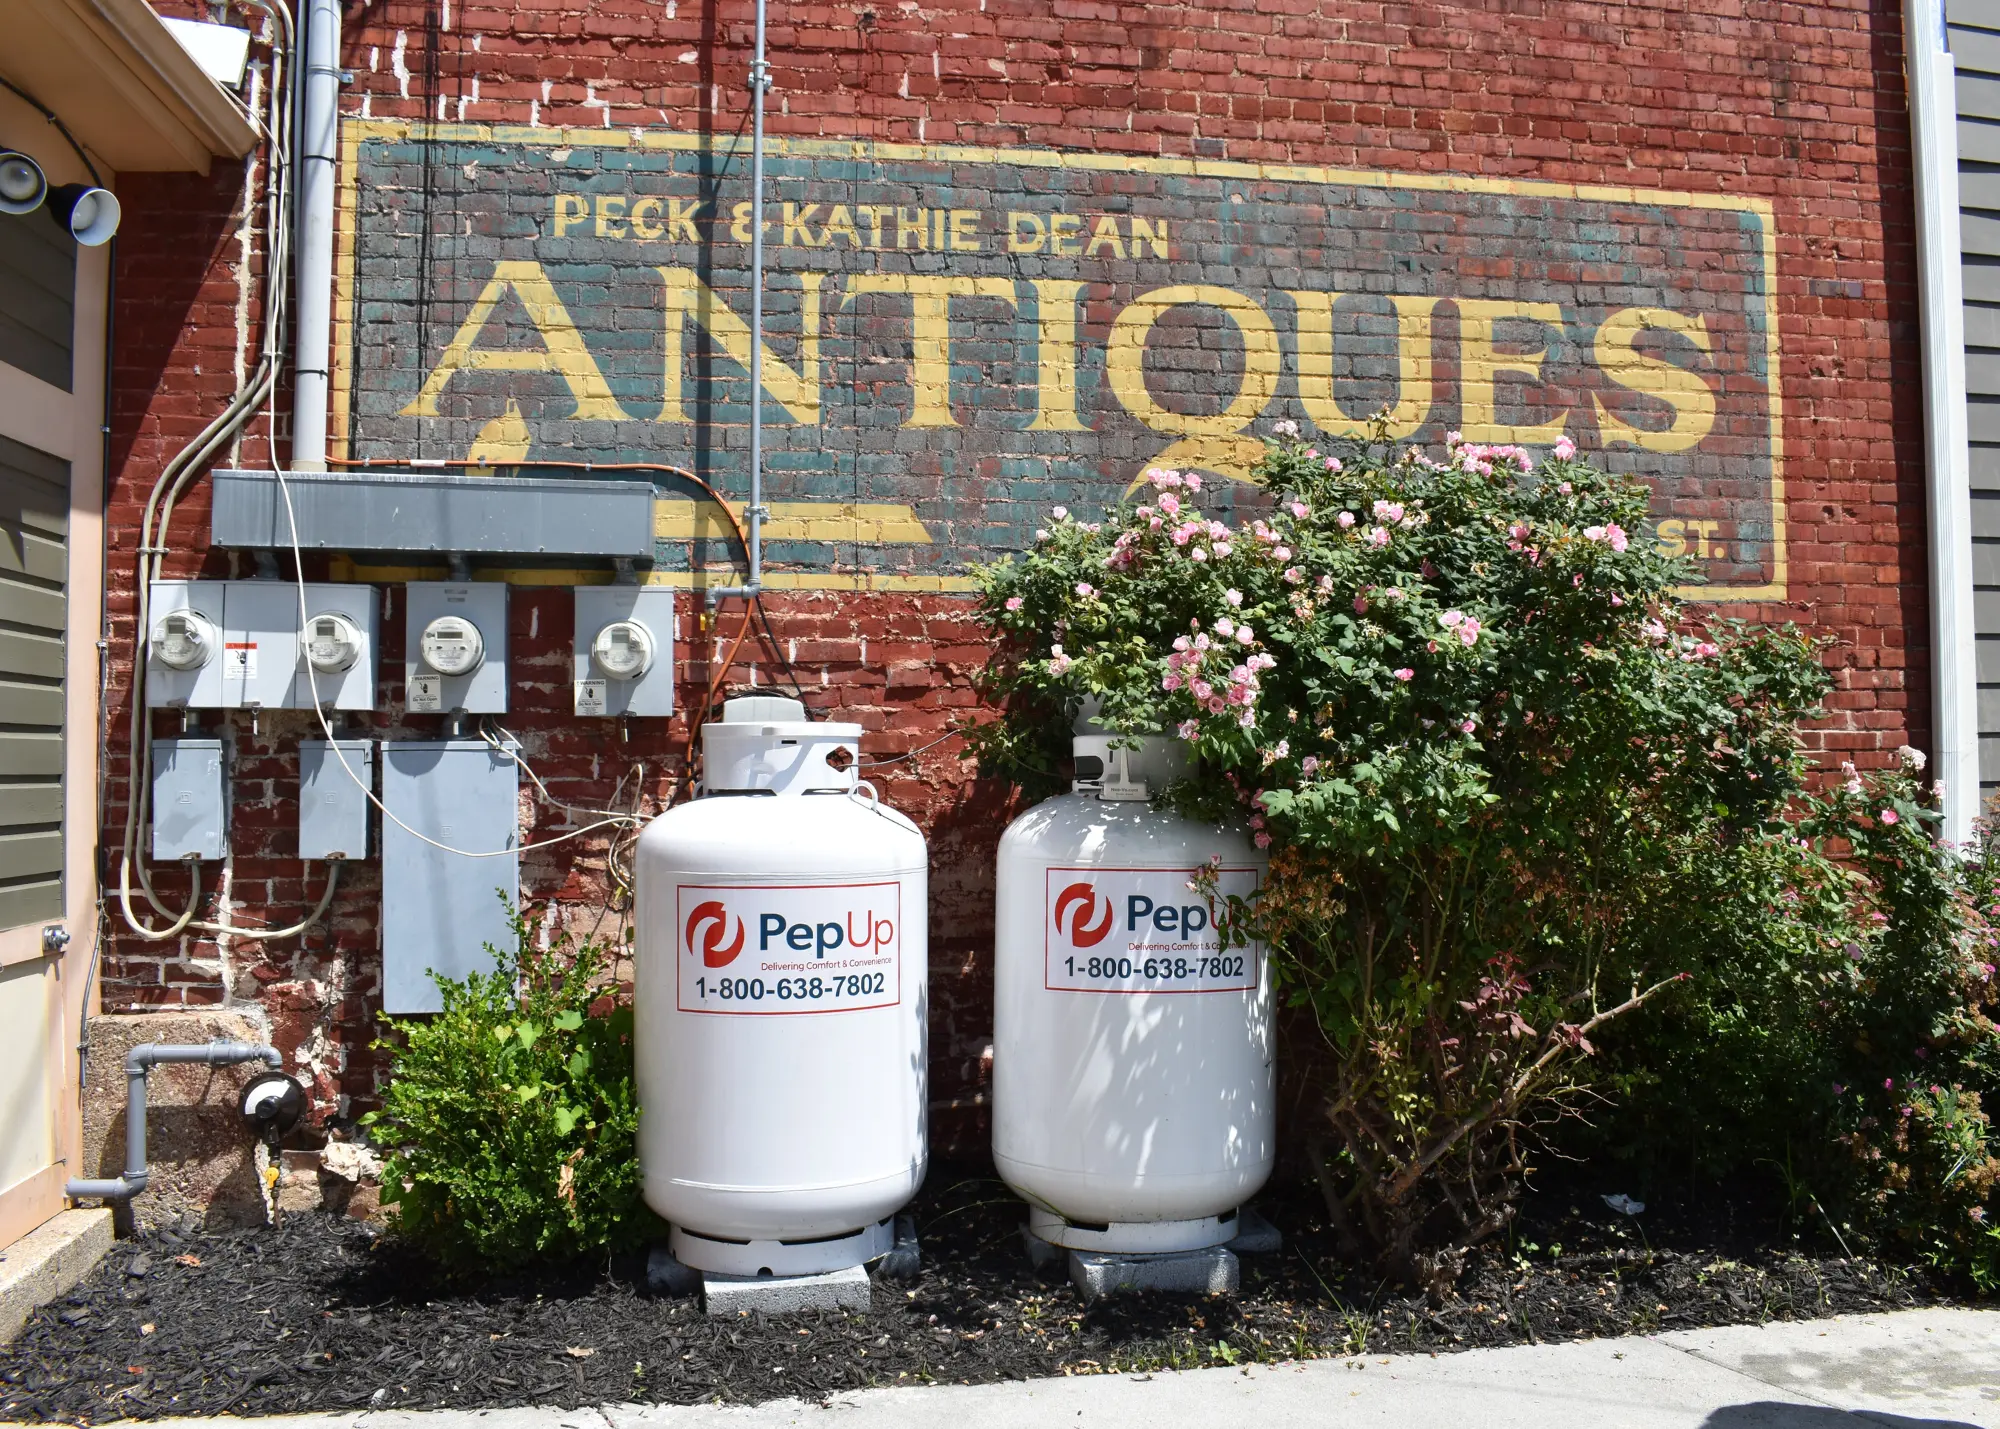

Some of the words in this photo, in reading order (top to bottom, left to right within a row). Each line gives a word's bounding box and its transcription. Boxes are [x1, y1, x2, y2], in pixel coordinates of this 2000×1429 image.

[552, 194, 707, 244] PECK
[730, 202, 771, 243] &
[783, 203, 982, 251] KATHIE
[1007, 211, 1168, 260] DEAN
[400, 260, 1716, 454] ANTIQUES
[1655, 519, 1725, 560] ST.
[760, 910, 894, 959] PepUp
[1128, 942, 1170, 952] Delivering
[1171, 941, 1204, 951] Comfort
[1205, 942, 1211, 950] &
[761, 961, 805, 972] Delivering
[806, 960, 840, 970] Comfort
[842, 959, 848, 968] &
[849, 957, 892, 968] Convenience
[1064, 955, 1244, 979] 1-800-638-7802
[696, 972, 885, 1000] 1-800-638-7802
